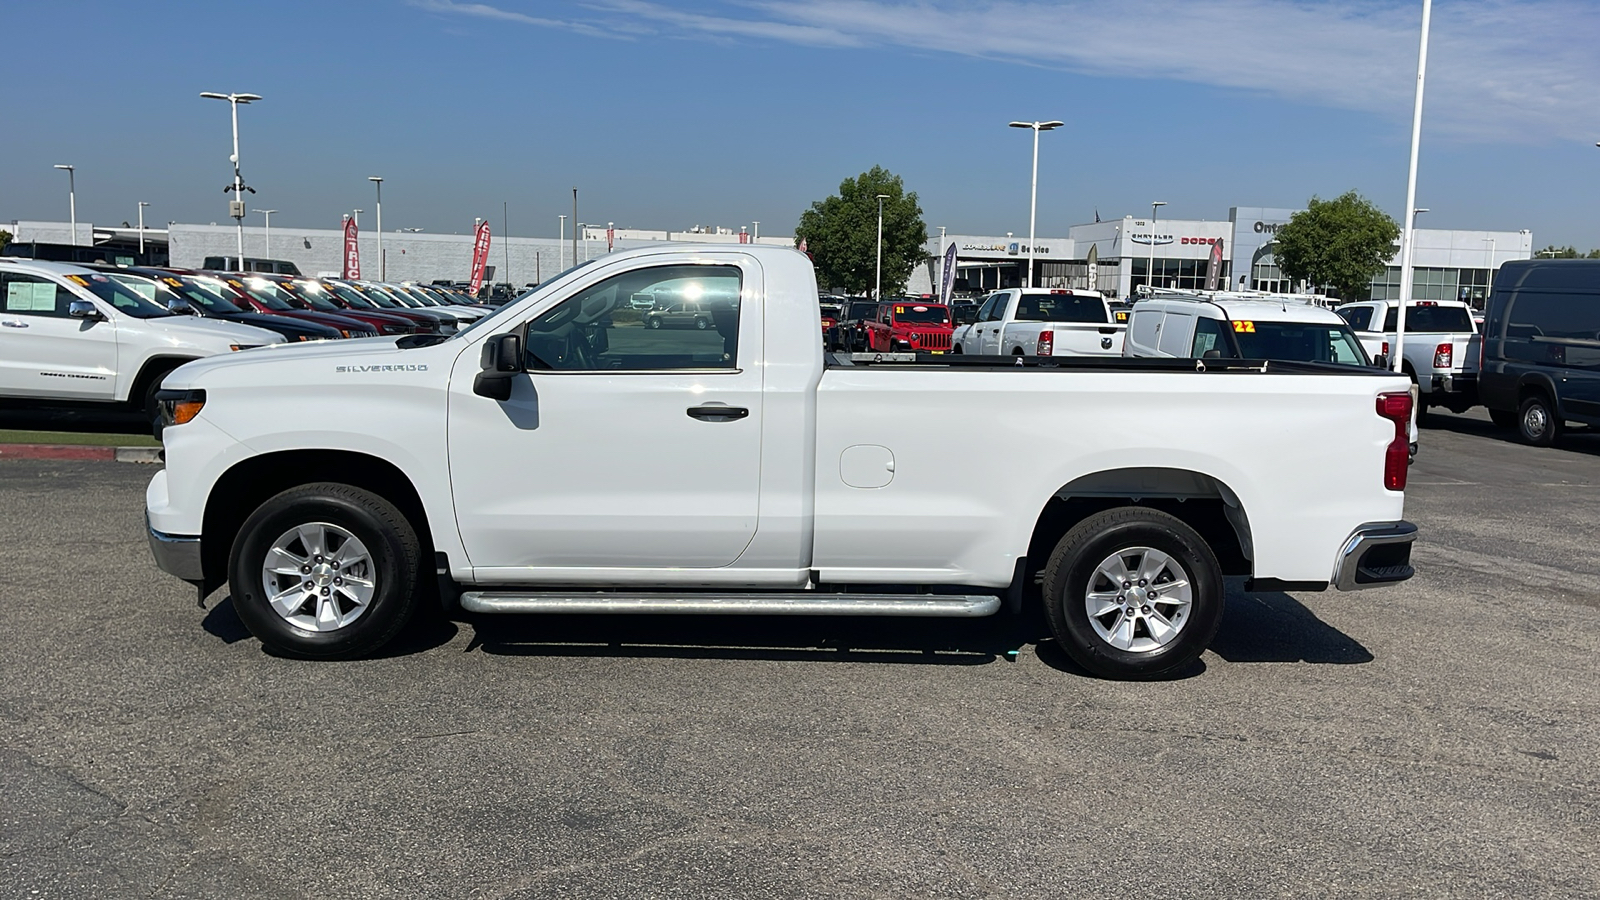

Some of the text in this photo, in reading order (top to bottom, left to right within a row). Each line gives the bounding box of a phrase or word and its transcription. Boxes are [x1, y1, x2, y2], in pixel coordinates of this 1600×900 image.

[1181, 237, 1216, 246] DODG
[1021, 244, 1049, 254] Sevice
[348, 242, 359, 279] TRUC
[1088, 263, 1097, 291] eep
[1233, 321, 1255, 333] 22
[335, 364, 428, 373] SILVERADO
